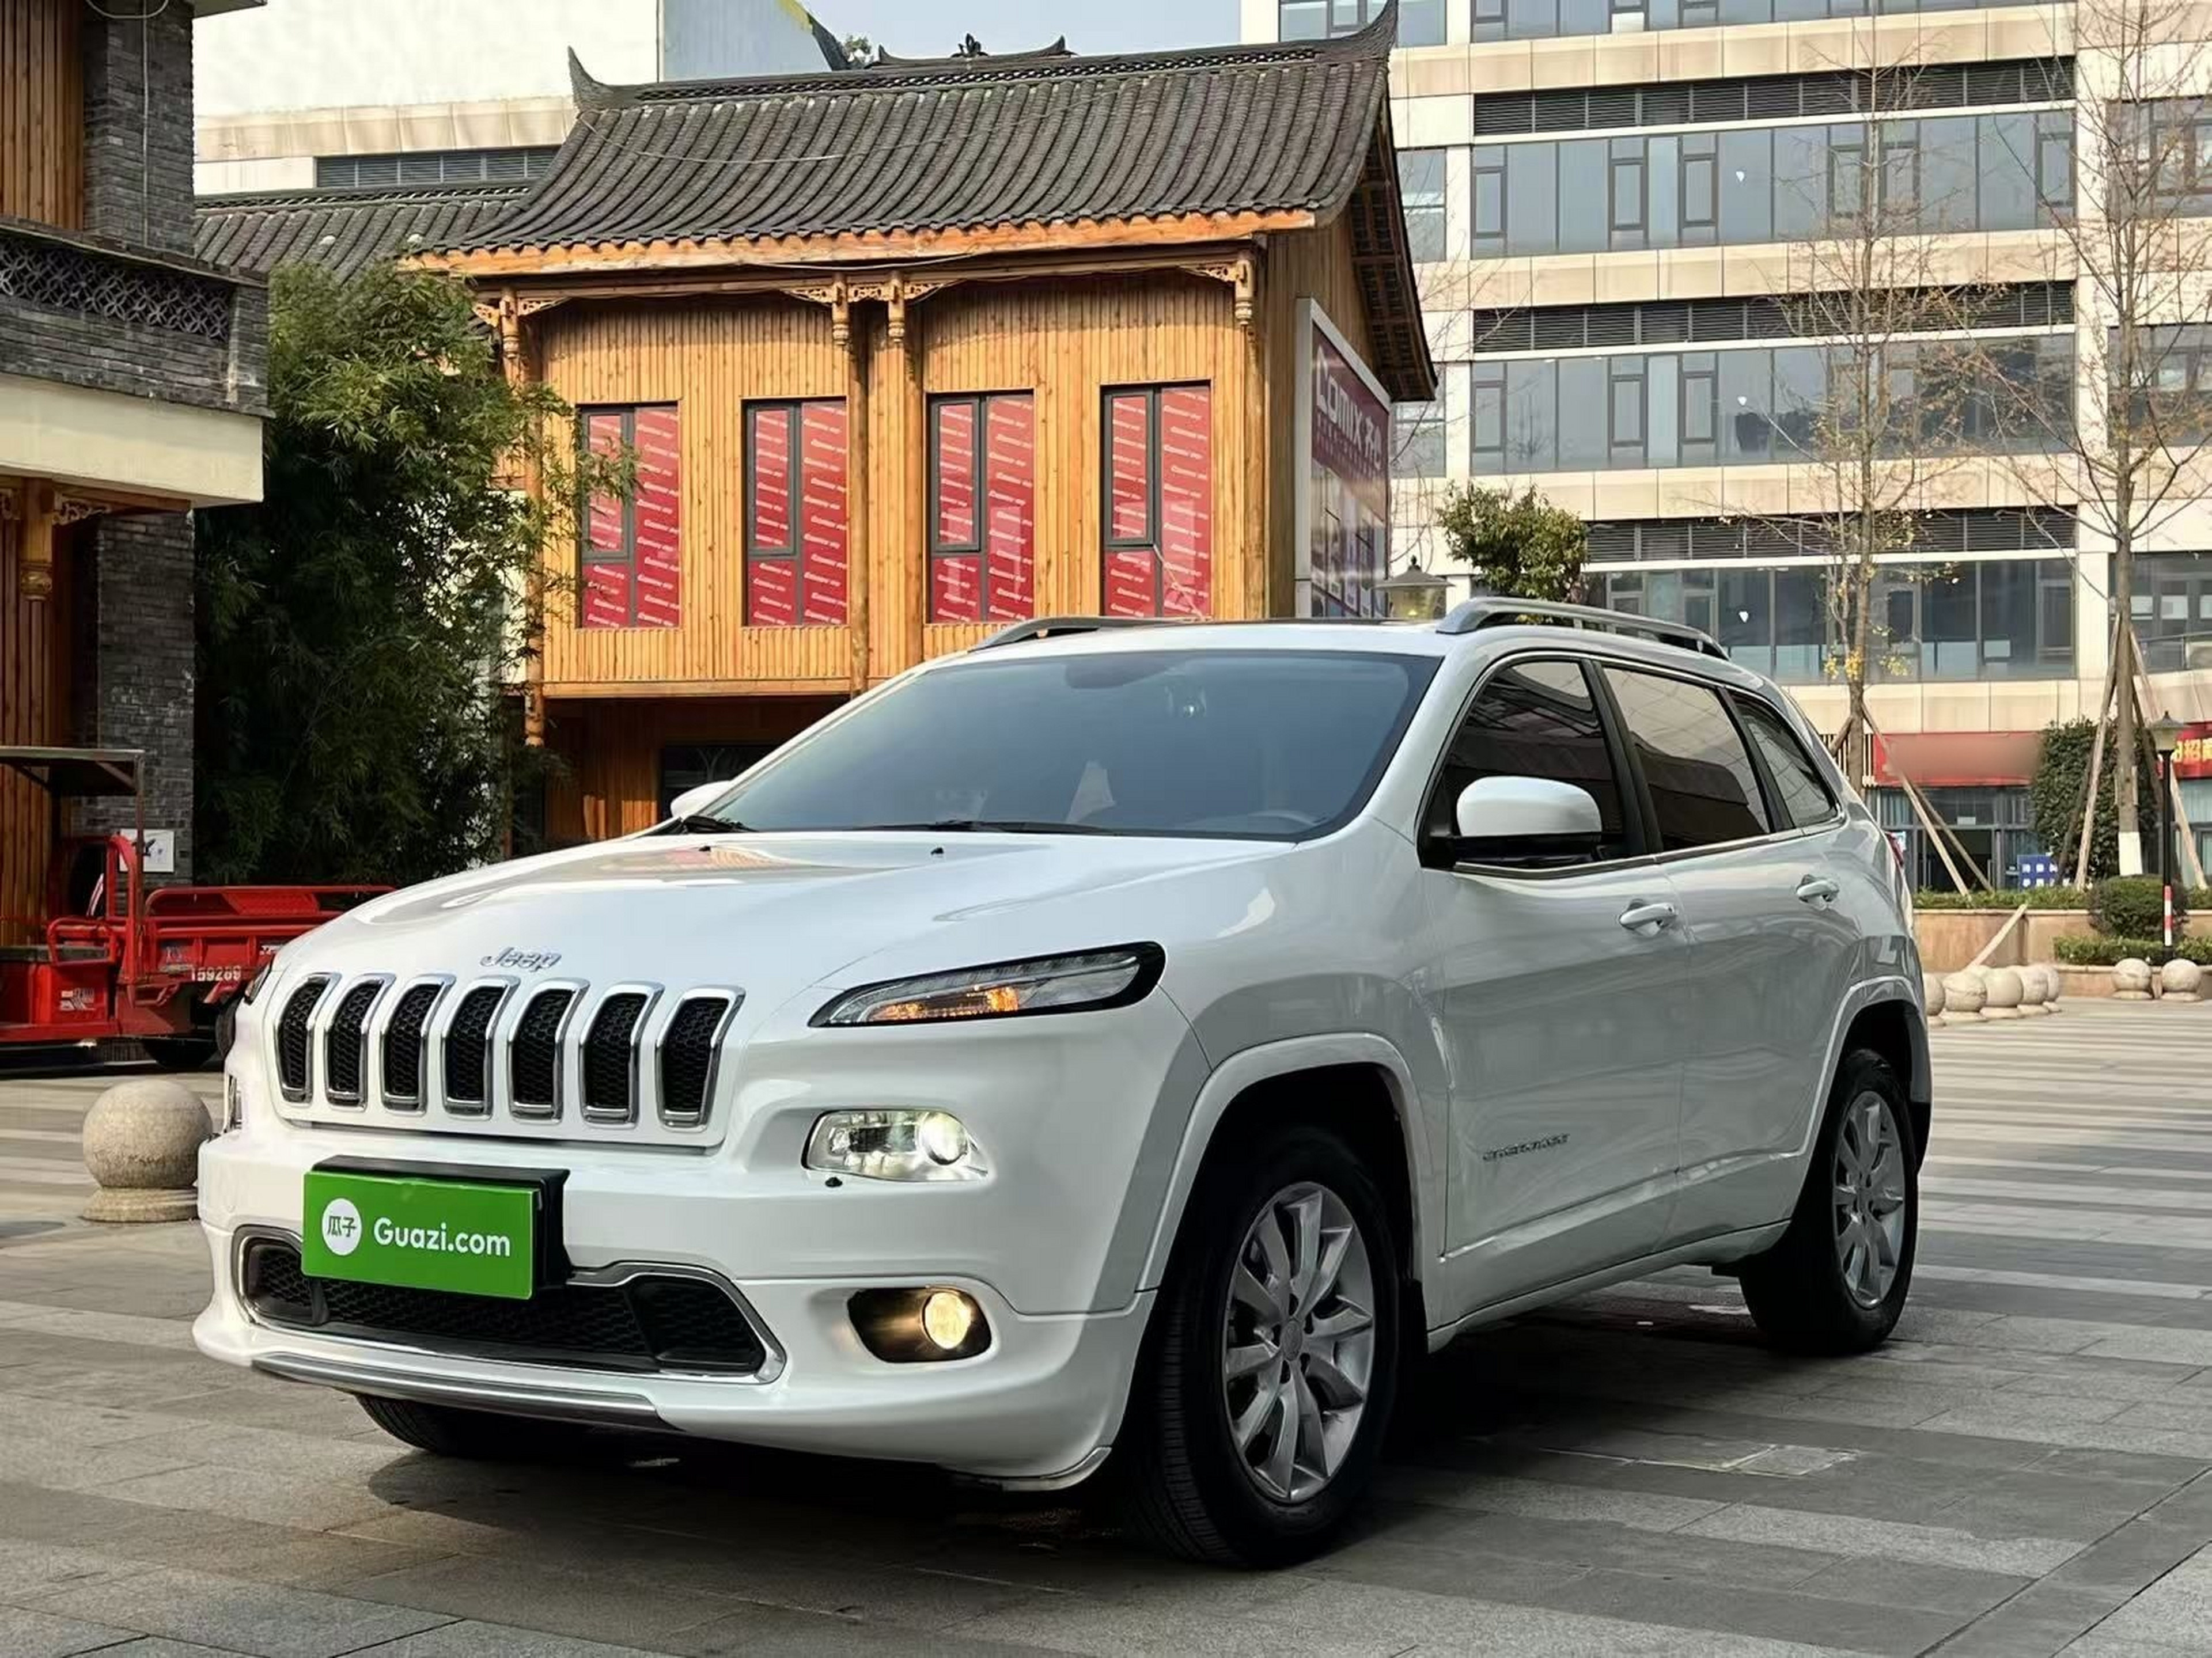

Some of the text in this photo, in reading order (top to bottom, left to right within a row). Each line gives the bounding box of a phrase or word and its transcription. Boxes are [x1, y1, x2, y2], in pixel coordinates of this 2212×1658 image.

[480, 947, 562, 973] Jeep
[328, 1215, 356, 1237] 瓜子
[374, 1217, 510, 1257] Guazi.com
